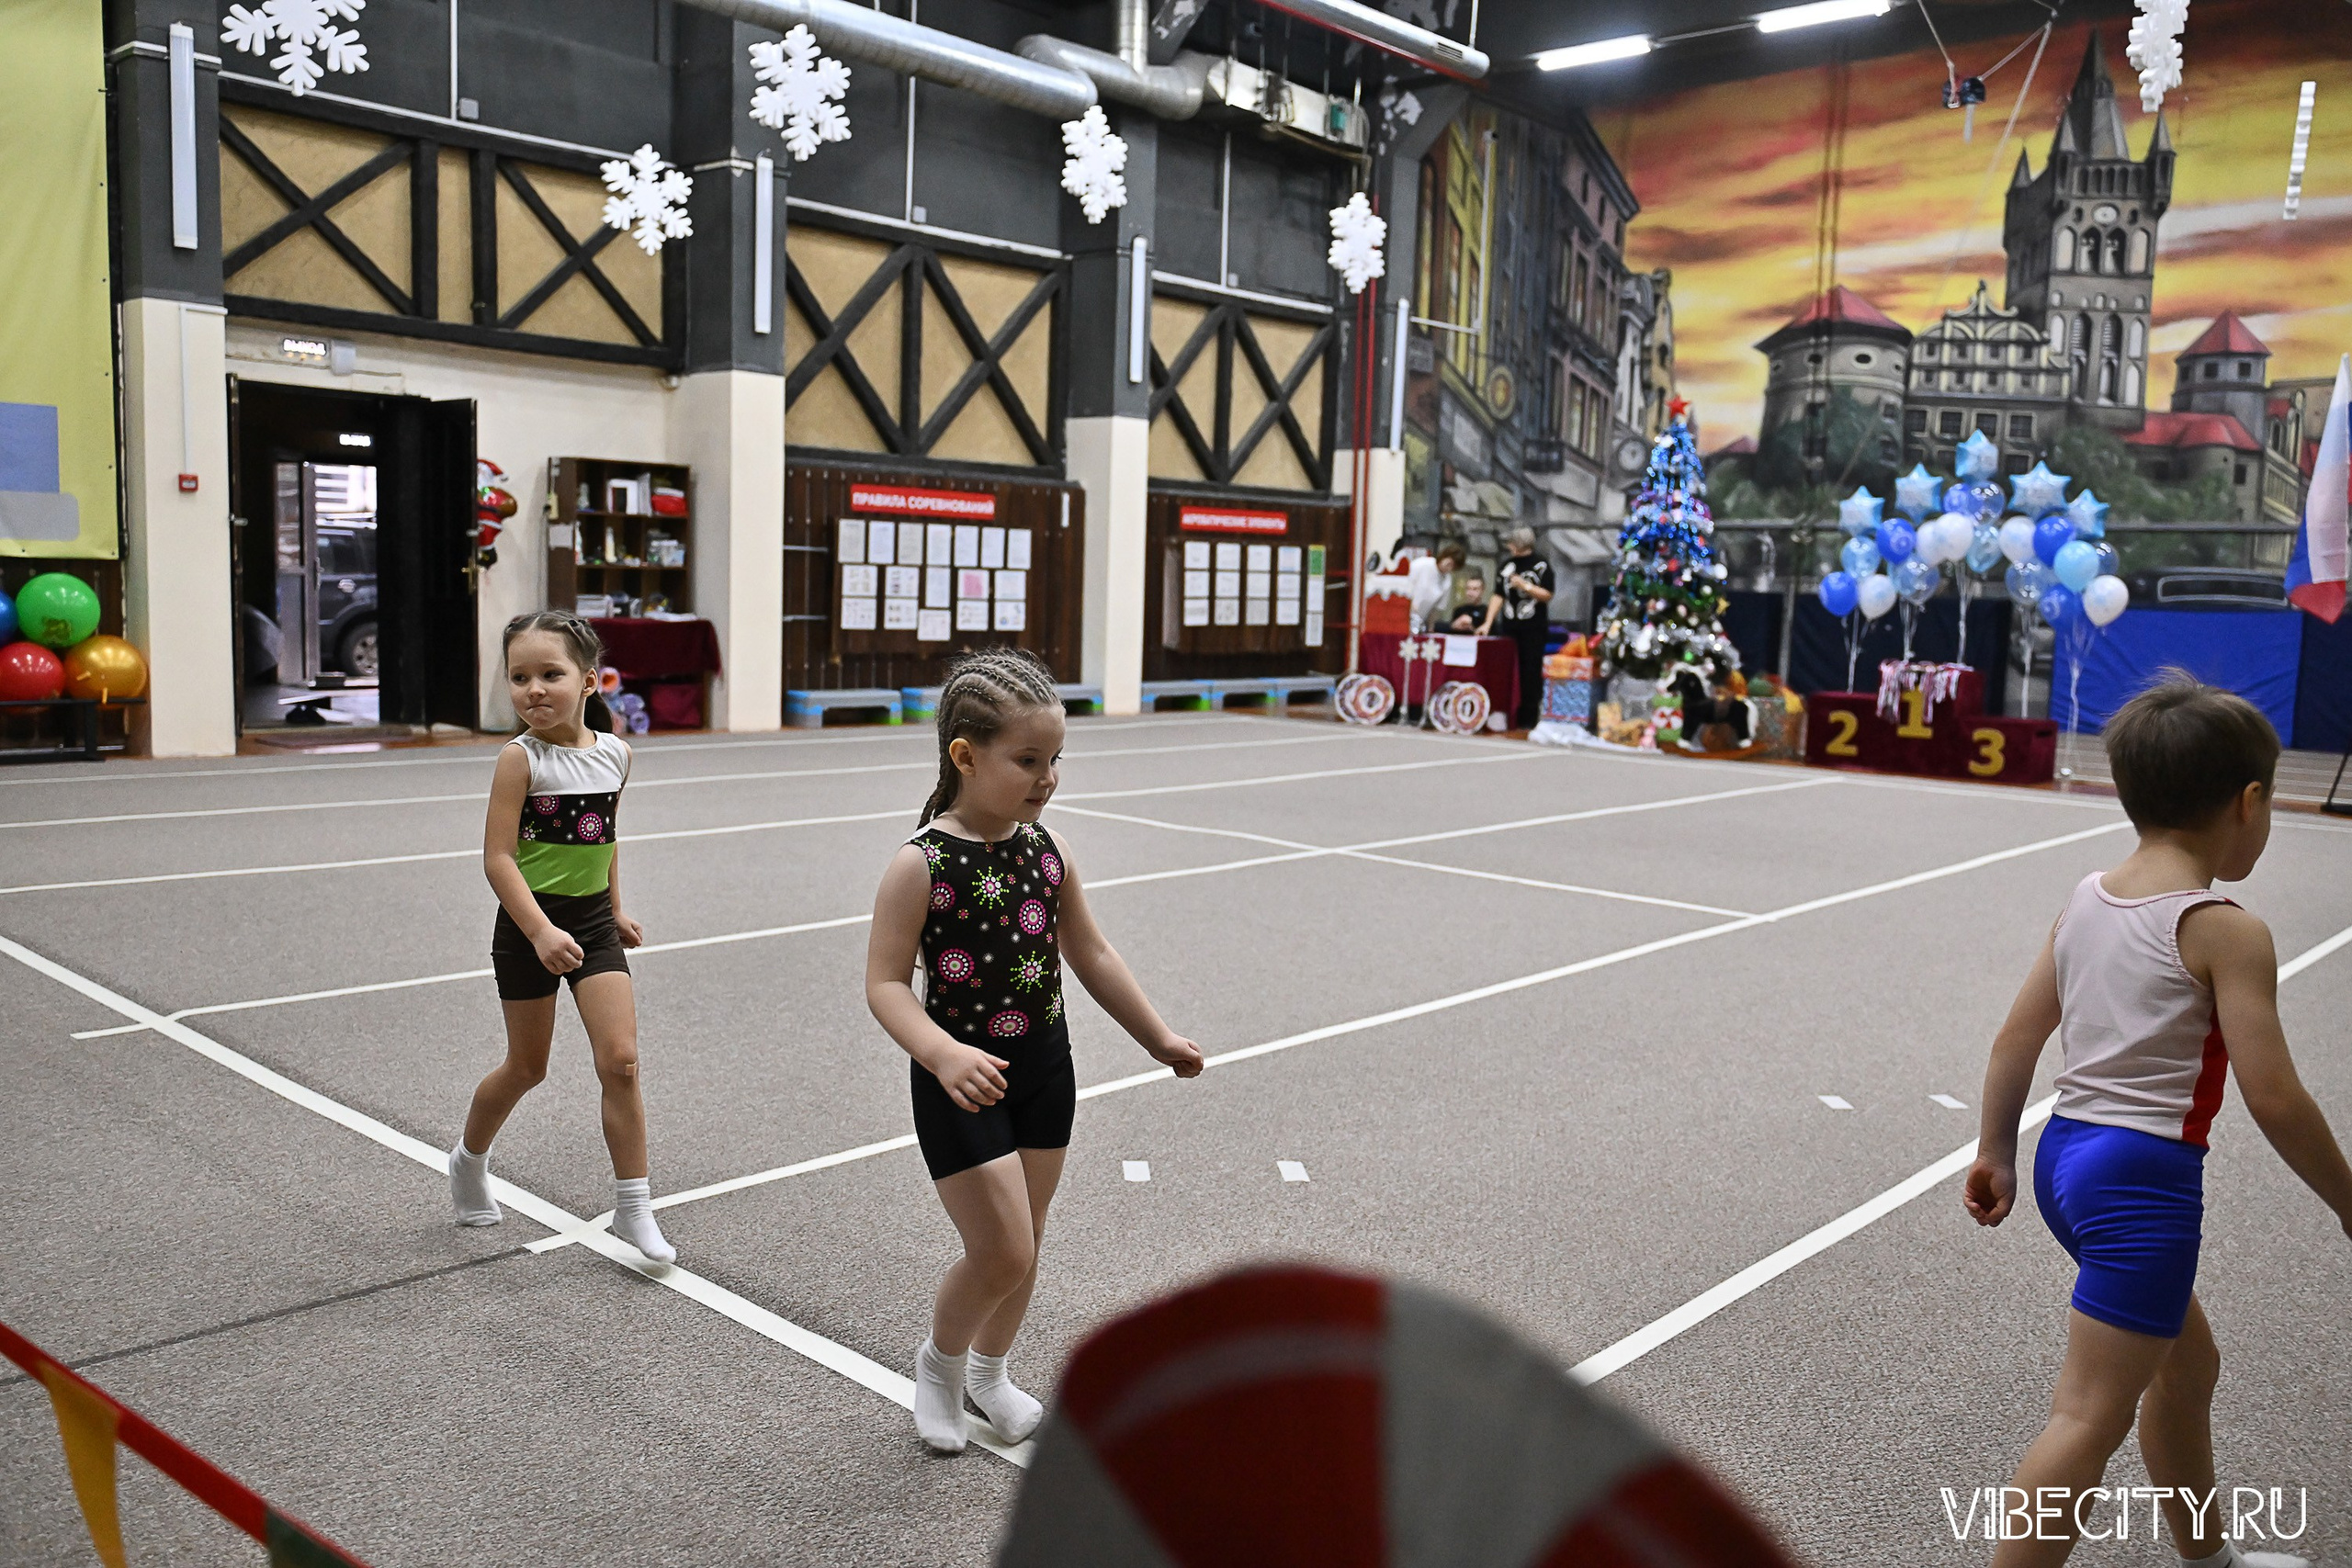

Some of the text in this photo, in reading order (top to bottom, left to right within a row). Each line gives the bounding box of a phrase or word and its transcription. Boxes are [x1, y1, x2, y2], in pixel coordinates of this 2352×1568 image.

[853, 491, 907, 508] ПРАВИЛА
[1825, 710, 1859, 757] 2
[1896, 683, 1933, 739] 1
[1968, 728, 2006, 776] 3
